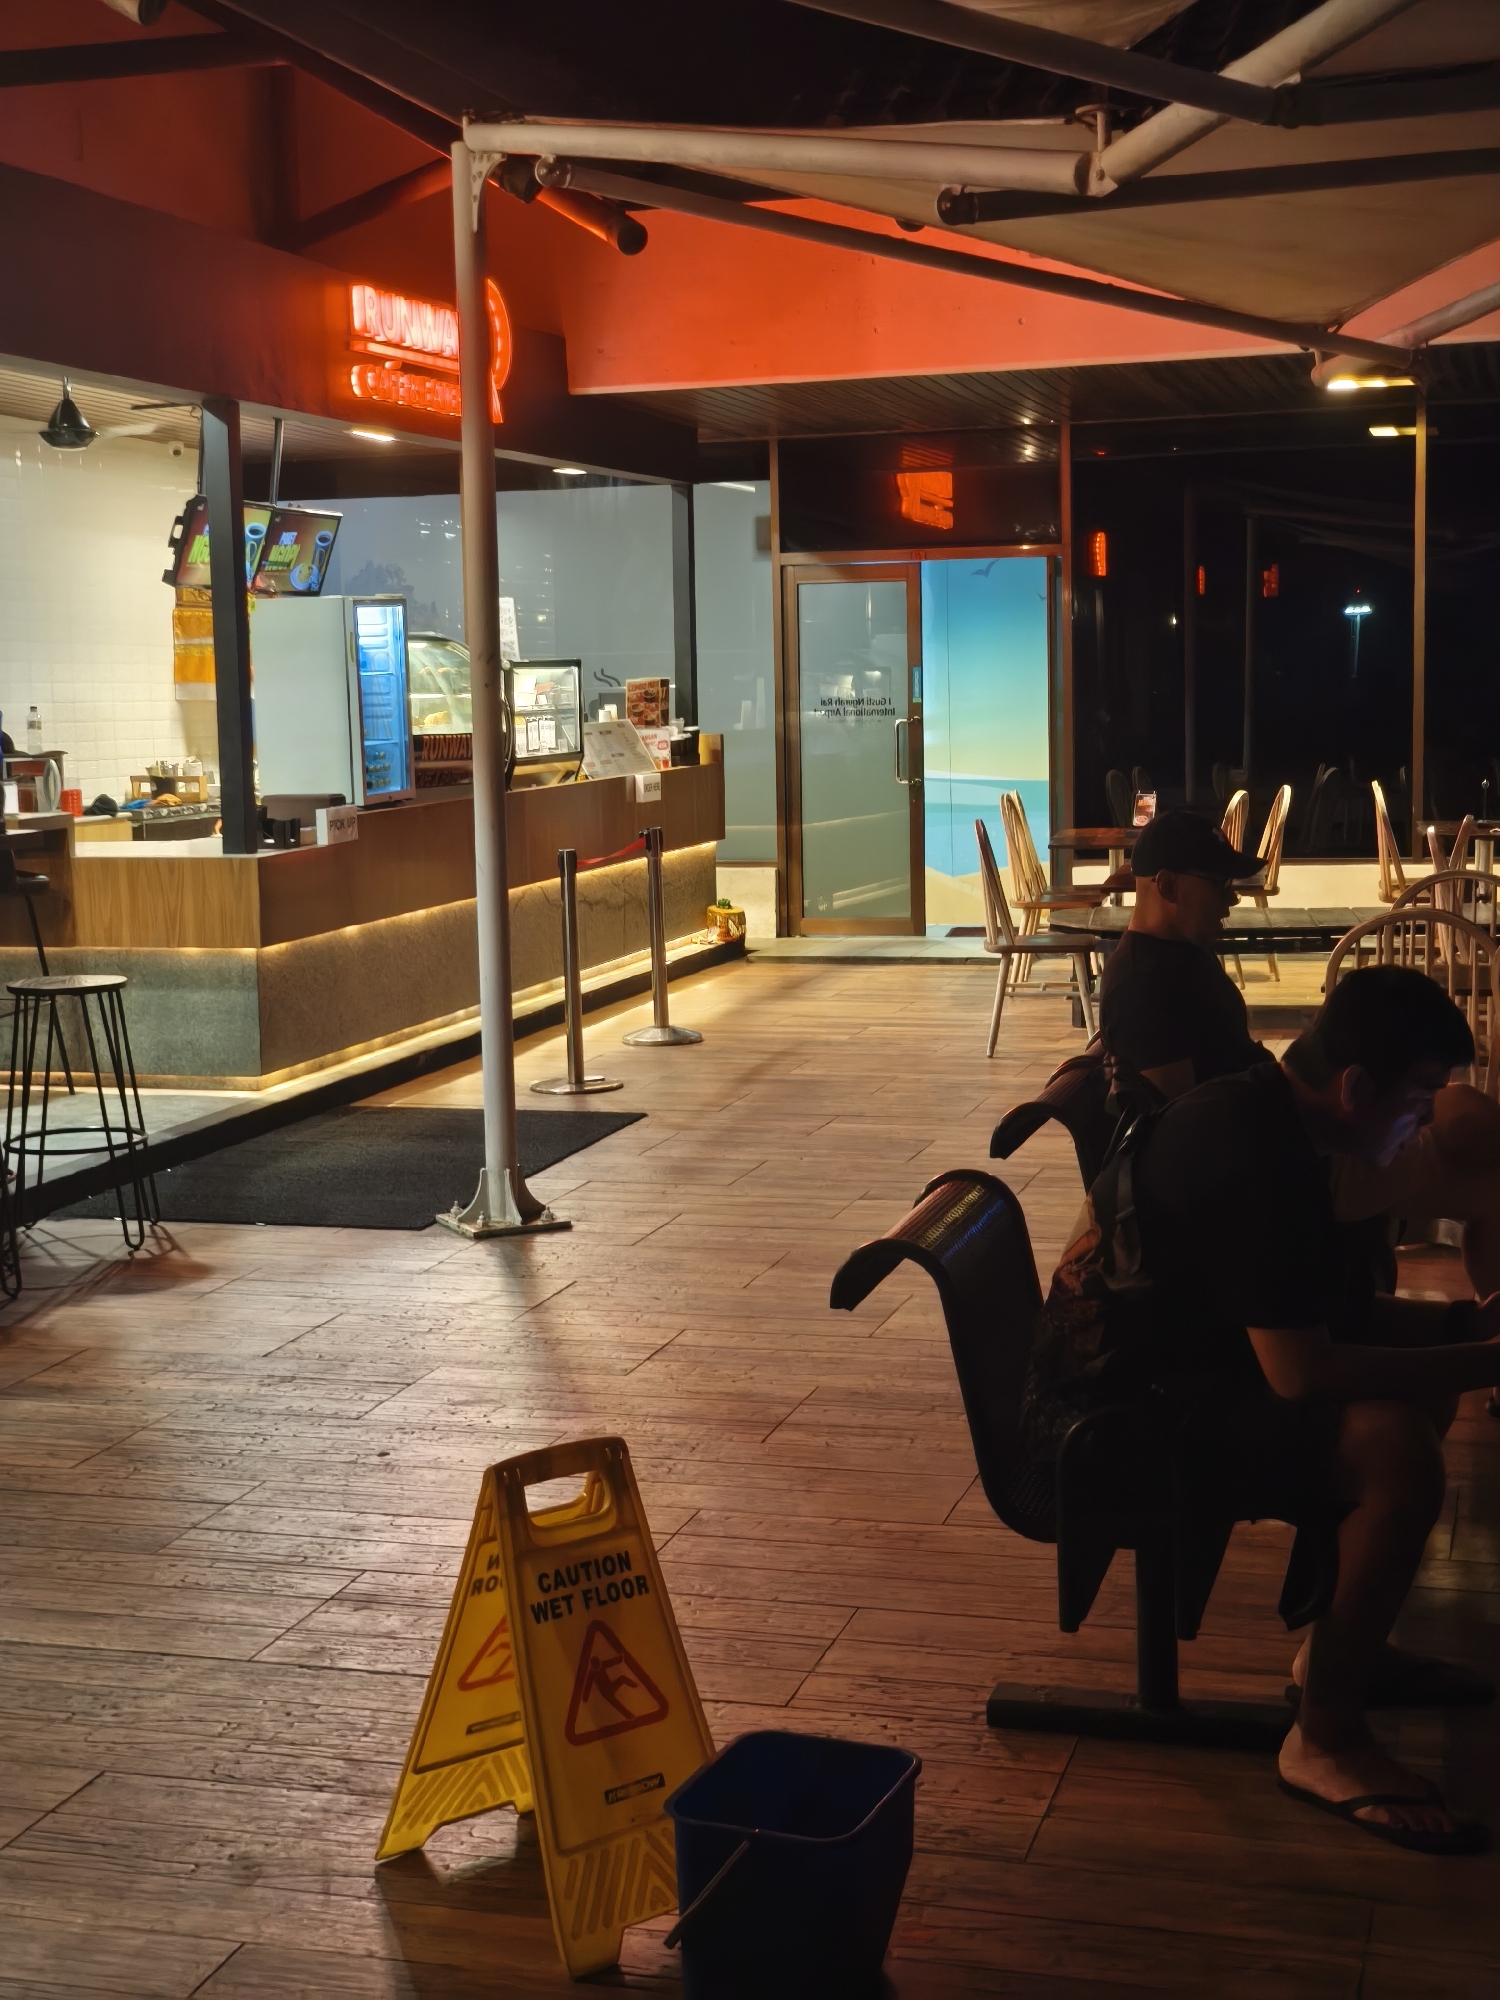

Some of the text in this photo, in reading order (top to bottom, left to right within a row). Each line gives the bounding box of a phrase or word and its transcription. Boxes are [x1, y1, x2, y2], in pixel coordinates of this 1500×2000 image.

[352, 285, 460, 359] RUNWA
[330, 816, 356, 831] PICK UP
[537, 1550, 633, 1593] CAUTION
[530, 1574, 650, 1624] WET FLOOR
